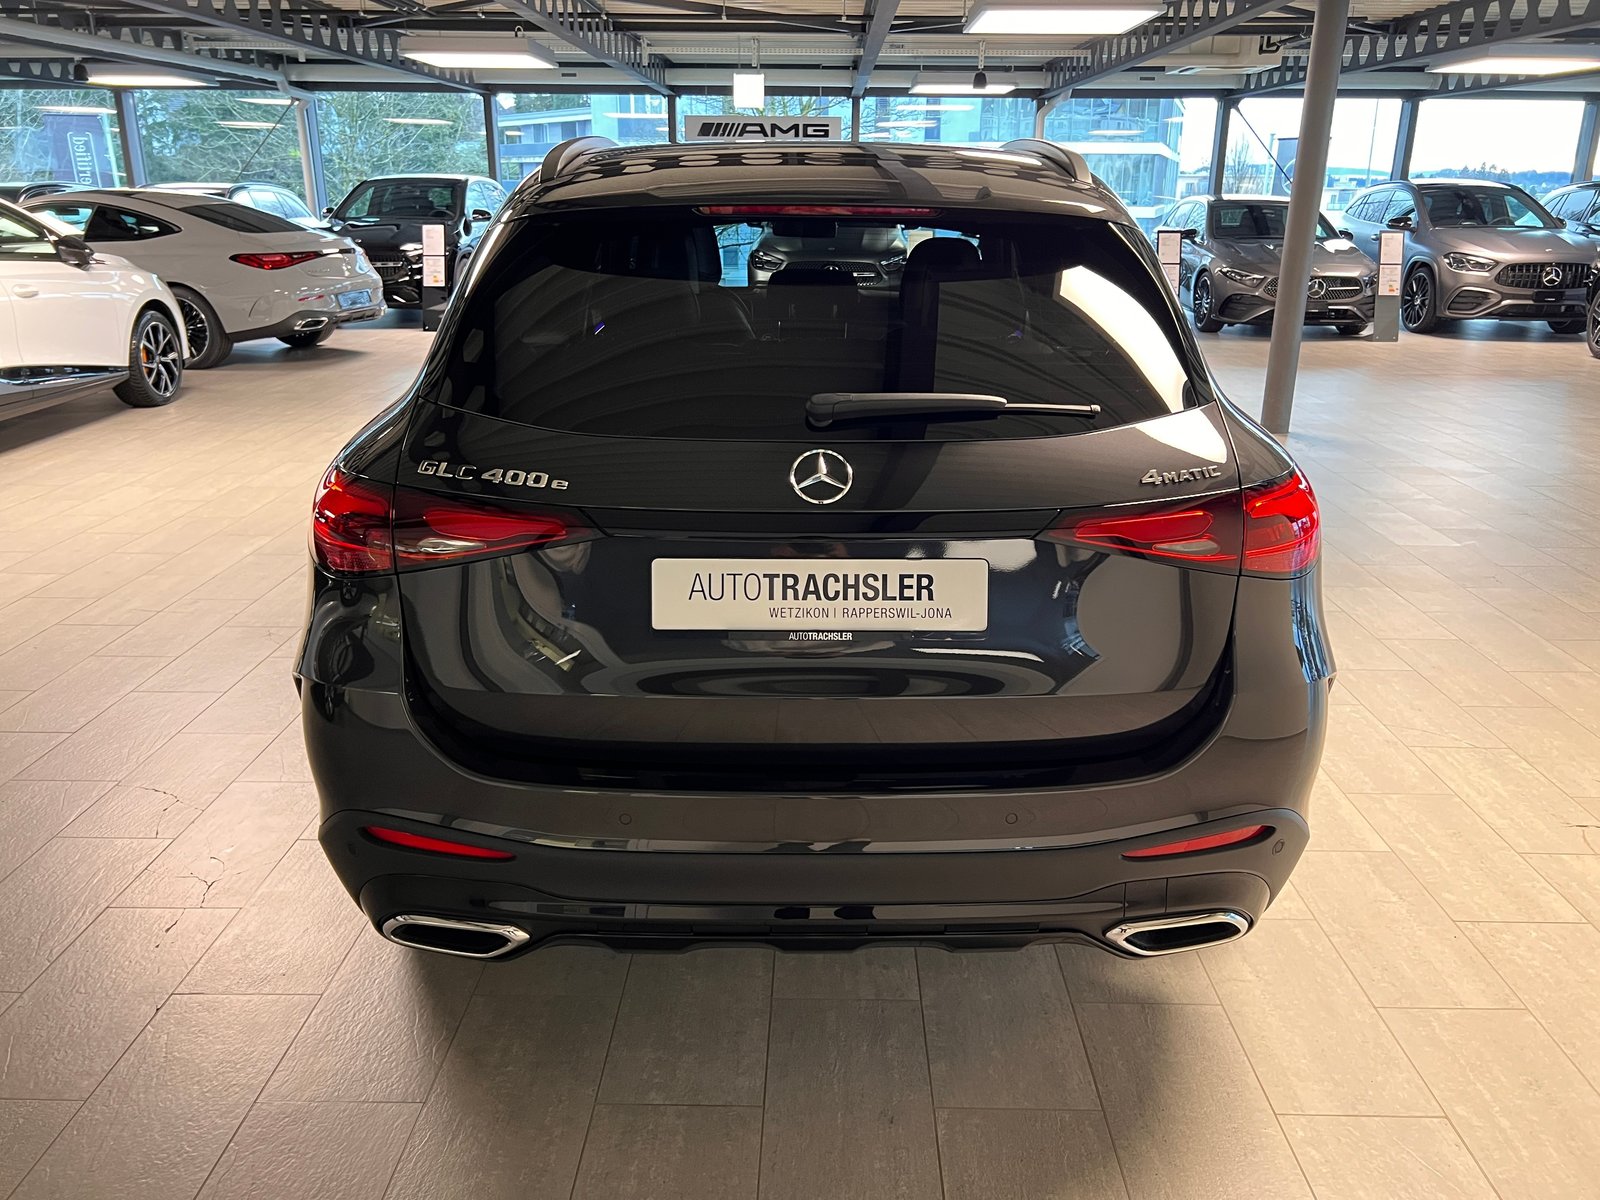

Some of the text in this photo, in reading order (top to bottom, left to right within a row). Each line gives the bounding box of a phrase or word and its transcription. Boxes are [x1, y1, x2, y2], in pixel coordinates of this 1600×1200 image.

[738, 122, 830, 138] AMG
[417, 459, 569, 490] GLC 400e
[1140, 465, 1222, 485] 4MATIC
[688, 573, 935, 601] AUTOTRACHSLER
[769, 607, 829, 619] WETZIKON
[842, 607, 953, 619] RAPPERSWIL-JONA
[788, 632, 853, 642] AUTOTRACHSLER
